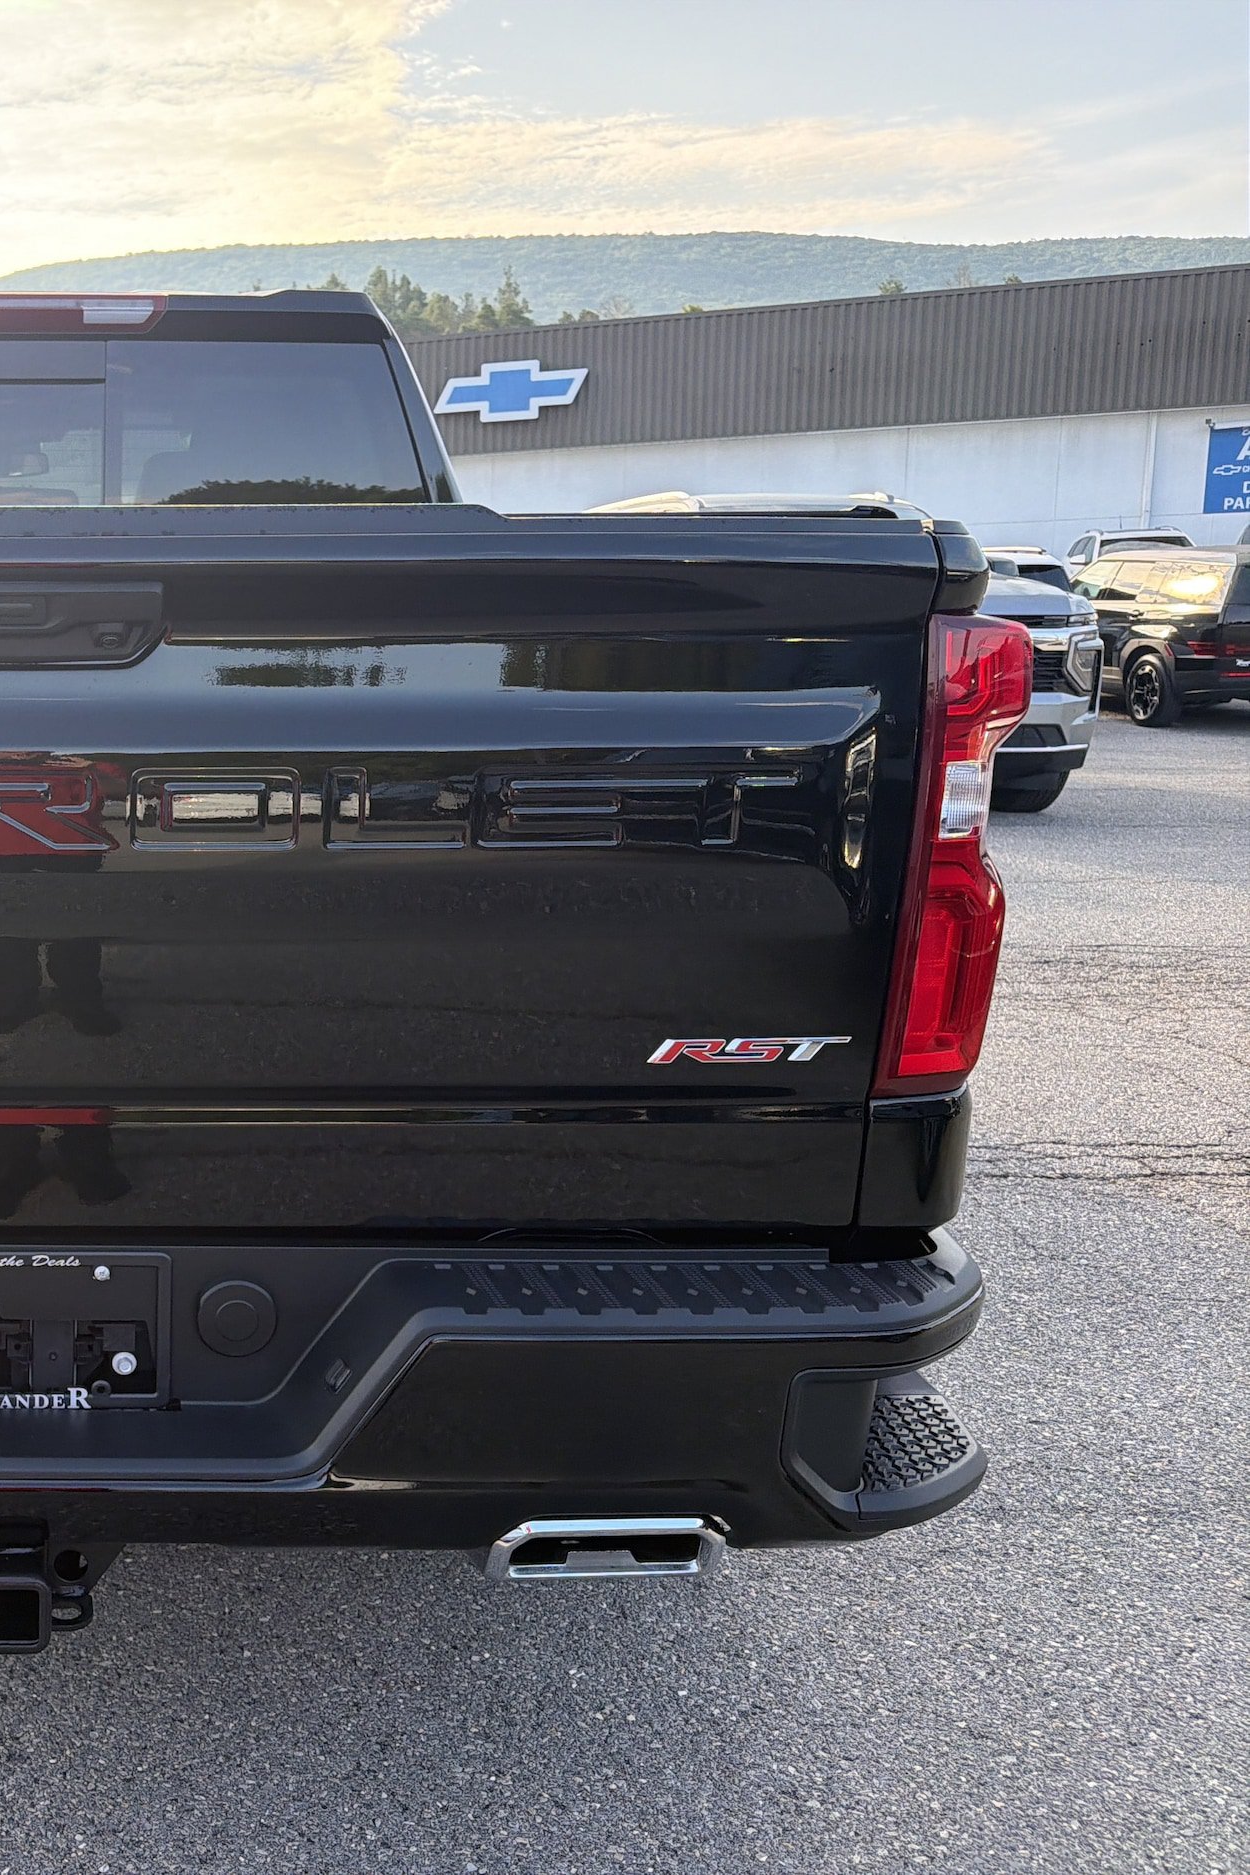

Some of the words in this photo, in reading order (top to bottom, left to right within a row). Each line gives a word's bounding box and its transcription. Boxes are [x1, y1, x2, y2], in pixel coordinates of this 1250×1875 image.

[646, 1036, 852, 1064] RST
[0, 1255, 25, 1267] the
[31, 1254, 81, 1267] Deals
